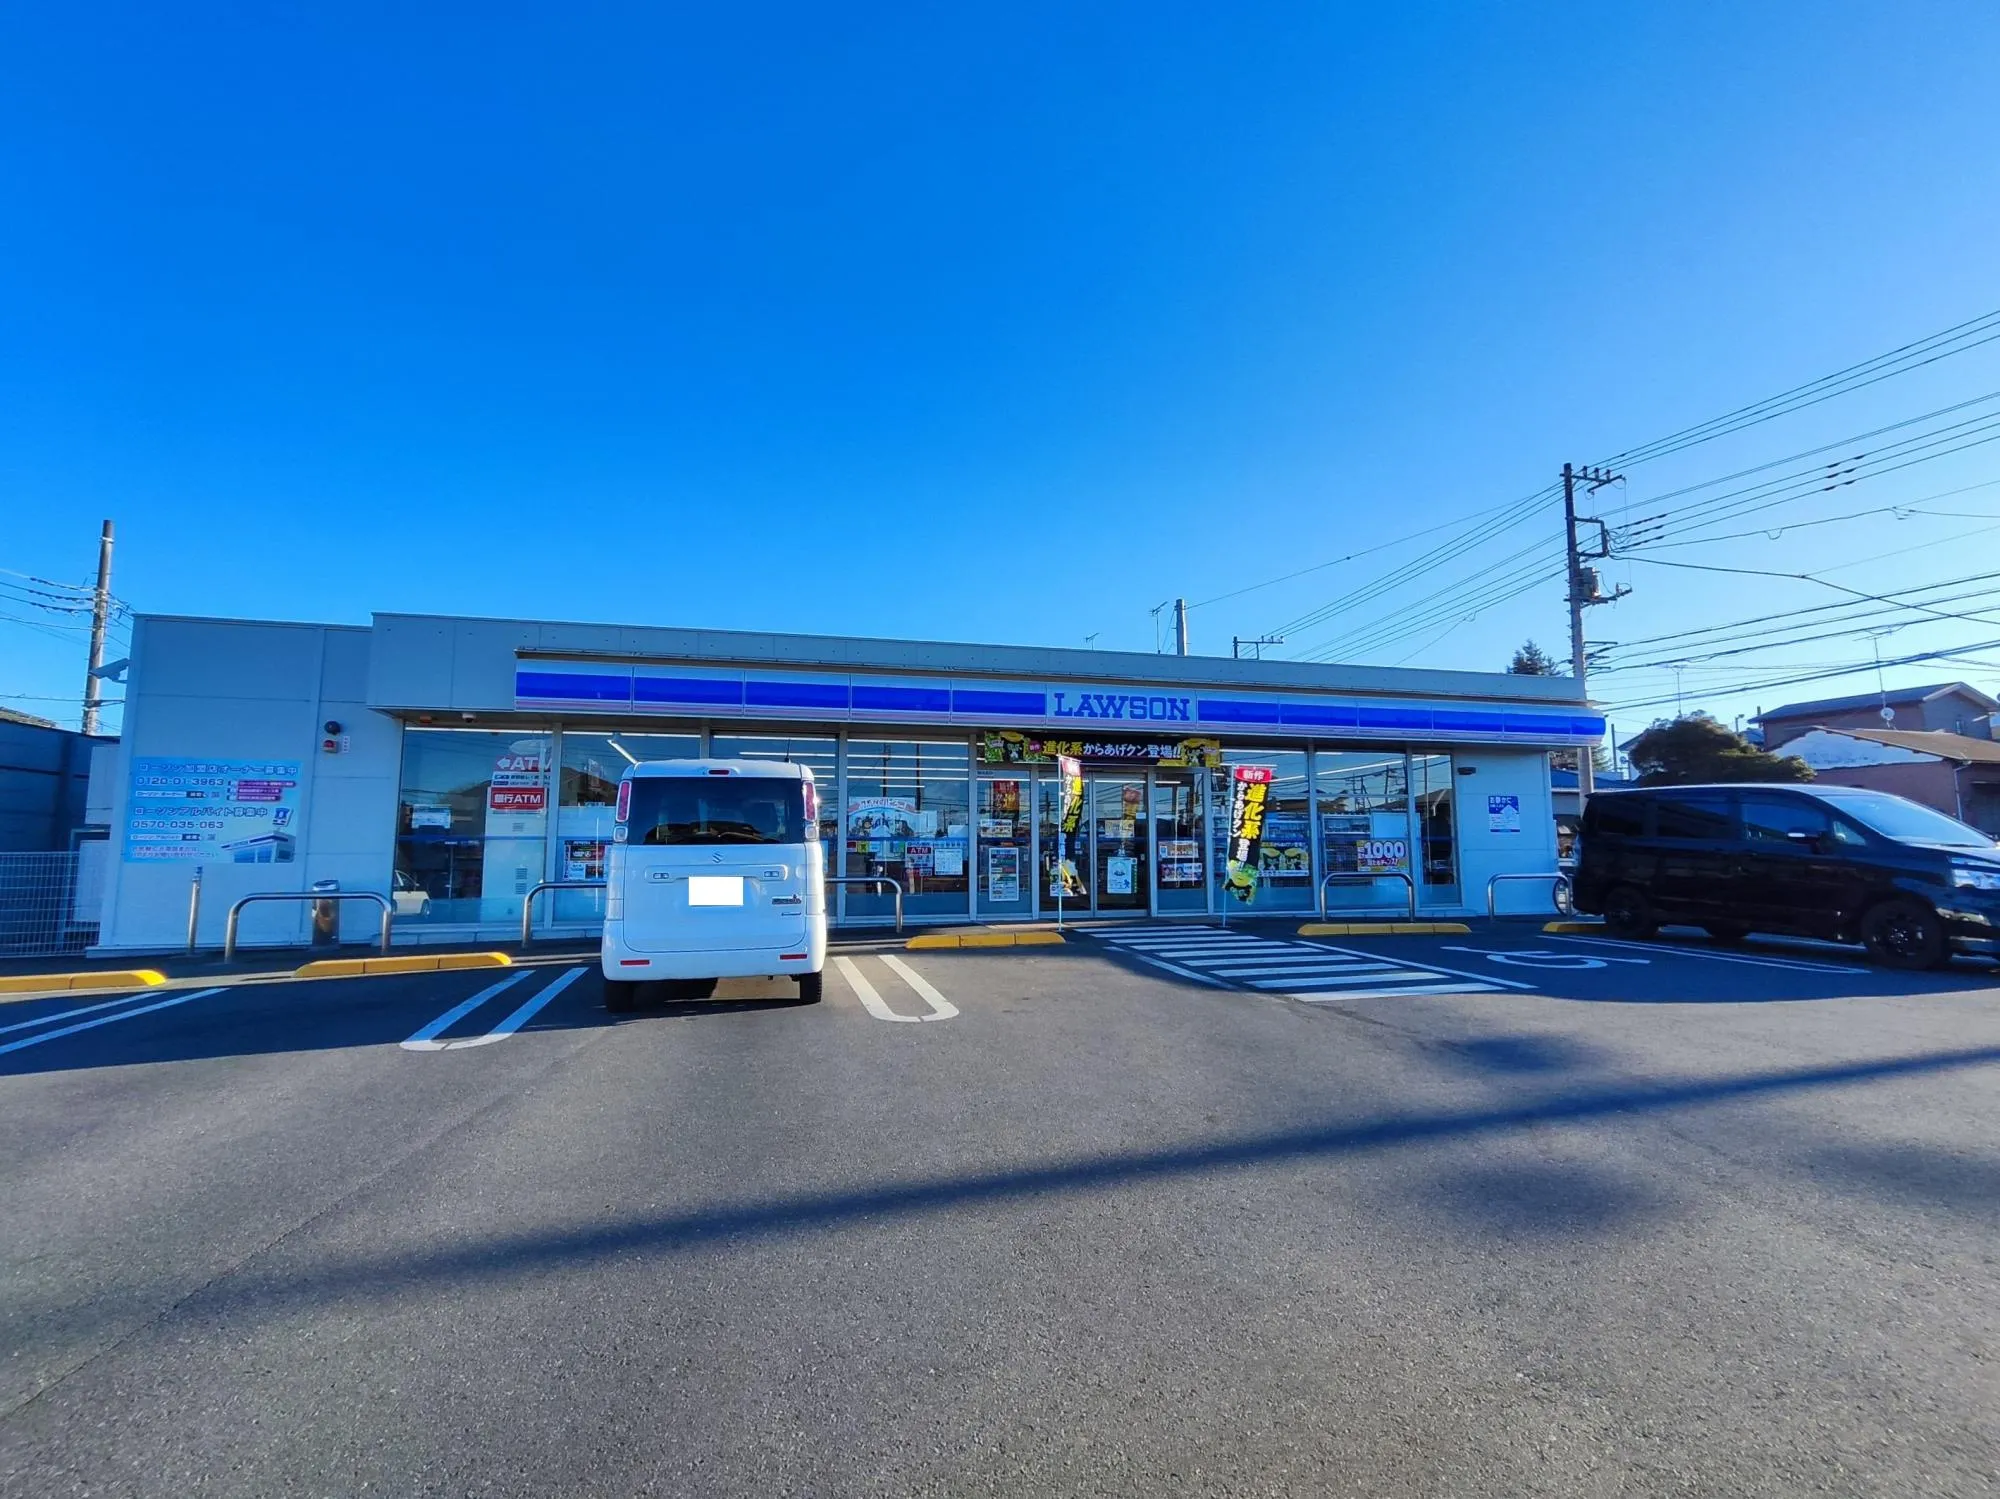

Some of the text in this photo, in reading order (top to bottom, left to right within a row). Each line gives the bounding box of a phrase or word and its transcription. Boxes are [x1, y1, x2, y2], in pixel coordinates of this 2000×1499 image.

[1054, 692, 1190, 721] LAWSON
[1243, 769, 1265, 780] 新作
[494, 794, 541, 804] 銀行ATM
[1062, 776, 1082, 832] 進化系
[1231, 781, 1248, 838] からあげクン
[1240, 783, 1268, 839] 進化系
[132, 821, 224, 829] 0570-035-063
[1364, 841, 1405, 859] 1000
